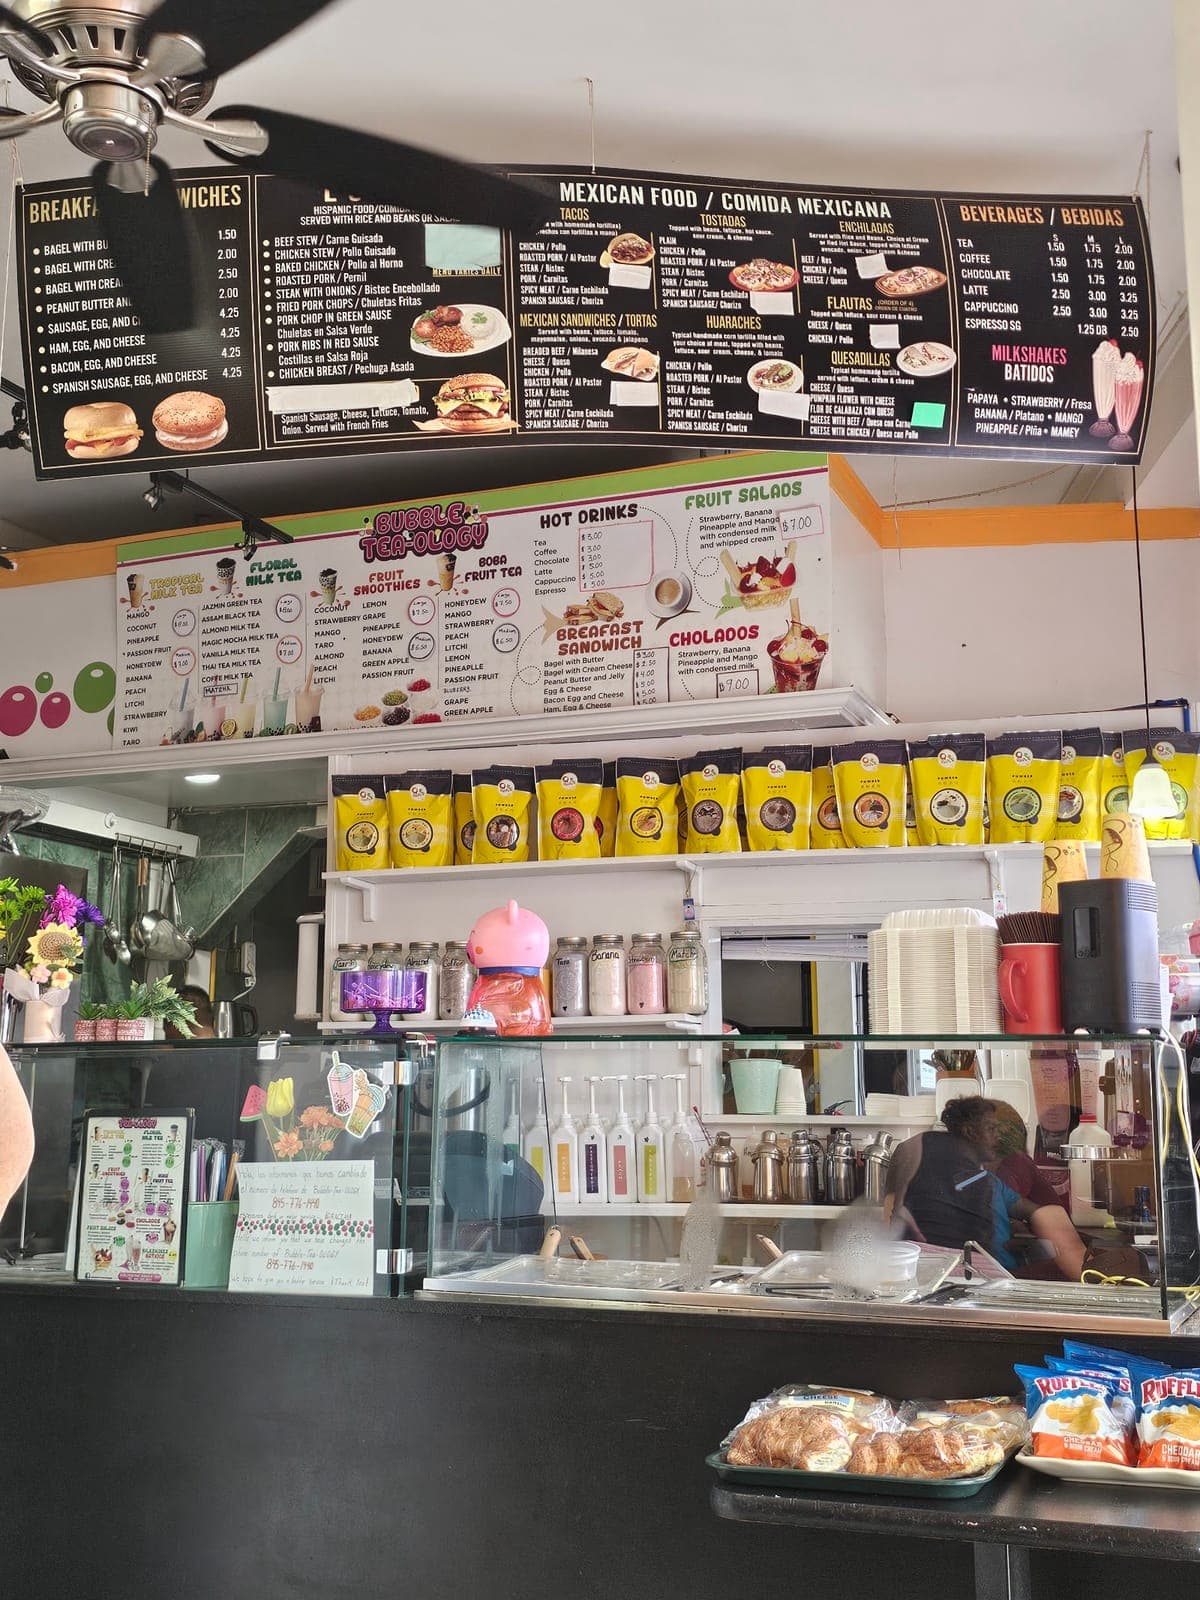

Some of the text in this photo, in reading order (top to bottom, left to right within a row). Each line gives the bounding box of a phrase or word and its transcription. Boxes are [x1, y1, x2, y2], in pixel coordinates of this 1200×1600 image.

[560, 182, 644, 205] MEXICAN
[650, 187, 698, 208] FOOD
[722, 192, 792, 214] COMIDA
[798, 198, 892, 218] MEXICANA
[560, 208, 590, 220] TACOS
[700, 214, 746, 227] TOSTADAS
[960, 206, 1044, 224] BEVERAGES
[1061, 208, 1124, 226] BEBIDAS
[839, 221, 894, 234] ENCHILADAS
[218, 229, 236, 240] 1.50
[274, 234, 383, 247] BEEF STEW Carne Guisada
[44, 241, 95, 255] BAGEL WITH
[957, 238, 1132, 254] TEA 1.50 1.75 2.00
[218, 249, 237, 260] 2.00
[960, 254, 1134, 270] COFFEE 1.50 1.75 2.00
[218, 268, 238, 280] 2.50
[276, 272, 366, 286] ROASTED PORK Pernil
[962, 269, 1136, 286] CHOCOLATE 1.50 1.75 2.00
[219, 288, 238, 299] 2.00
[964, 286, 988, 296] LATTE
[47, 298, 114, 314] PEANUT BUTTER
[828, 296, 872, 310] FLAUTAS
[964, 302, 1018, 314] CAPPUCCINO
[220, 307, 239, 318] 4.25
[277, 310, 392, 326] PORK CHOP IN GREEN SAUSE
[520, 314, 558, 326] MEXICAN
[561, 314, 616, 326] SANDWICHES
[626, 314, 657, 327] TORTAS
[706, 315, 761, 330] HUARACHES
[966, 319, 1008, 330] ESPRESSO
[220, 327, 240, 338] 4.25
[278, 328, 312, 338] Chuletas
[326, 326, 348, 336] Salsa
[350, 324, 372, 334] Verde
[50, 335, 146, 354] HAM, EGG, AND CHEESE
[278, 336, 379, 352] PORK RIBS IN RED SAUSE
[222, 346, 241, 358] 4.25
[832, 350, 890, 366] QUESADILLAS
[992, 345, 1068, 365] MILKSHAKES
[51, 354, 157, 374] BACON, EGG, AND CHEESE
[222, 366, 242, 378] 4.25
[1004, 364, 1054, 382] BATIDOS
[52, 370, 208, 394] SPANISH SAUSAGE, EGG, AND CHEESE
[968, 394, 1064, 408] PAPAYA STRAWBERRY
[974, 408, 1083, 423] BANANA MANGO
[976, 423, 1080, 438] PINEAPPLE MAMEY
[685, 481, 802, 510] FRUIT SALADS
[375, 502, 465, 533] BUBBLE
[540, 504, 638, 528] HOT DRINKS
[700, 508, 772, 524] Strawberry, Banana
[700, 525, 777, 541] with condensed milk
[360, 523, 488, 562] TEA-OLOGY
[534, 548, 557, 556] Coffee
[250, 558, 297, 574] FLORAL
[479, 555, 506, 568] BOBA
[534, 556, 570, 566] Chocolate
[246, 570, 302, 586] MILK TEA
[369, 570, 404, 582] FRUIT
[465, 566, 522, 582] FRUIT TEA
[534, 568, 552, 576] Latte
[150, 573, 204, 589] TROPICAL
[535, 576, 576, 587] Cappuccino
[151, 584, 202, 600] MILK TEA
[354, 580, 420, 596] SMOOTHIES
[535, 587, 566, 596] Espresso
[445, 598, 486, 608] HONEYDEW
[127, 611, 150, 620] MANGO
[362, 612, 386, 621] GRAPE
[127, 623, 156, 632] COCONUT
[202, 626, 229, 634] ALMOND
[362, 622, 400, 633] PINEAPPLE
[445, 619, 494, 630] STRAWBERRY
[445, 632, 469, 640] PEACH
[556, 621, 643, 642] BREAFAST
[670, 625, 760, 647] CHOLADOS
[127, 635, 159, 645] PINEAPPLE
[558, 636, 642, 656] SANDWICH
[362, 657, 409, 668] GREEN APPLE
[445, 654, 470, 662] LEMON
[544, 660, 564, 668] Bagel
[582, 656, 604, 664] Butter
[126, 660, 162, 670] HONEYDEW
[124, 711, 167, 720] STRAWBERRY
[592, 950, 620, 962] Banana
